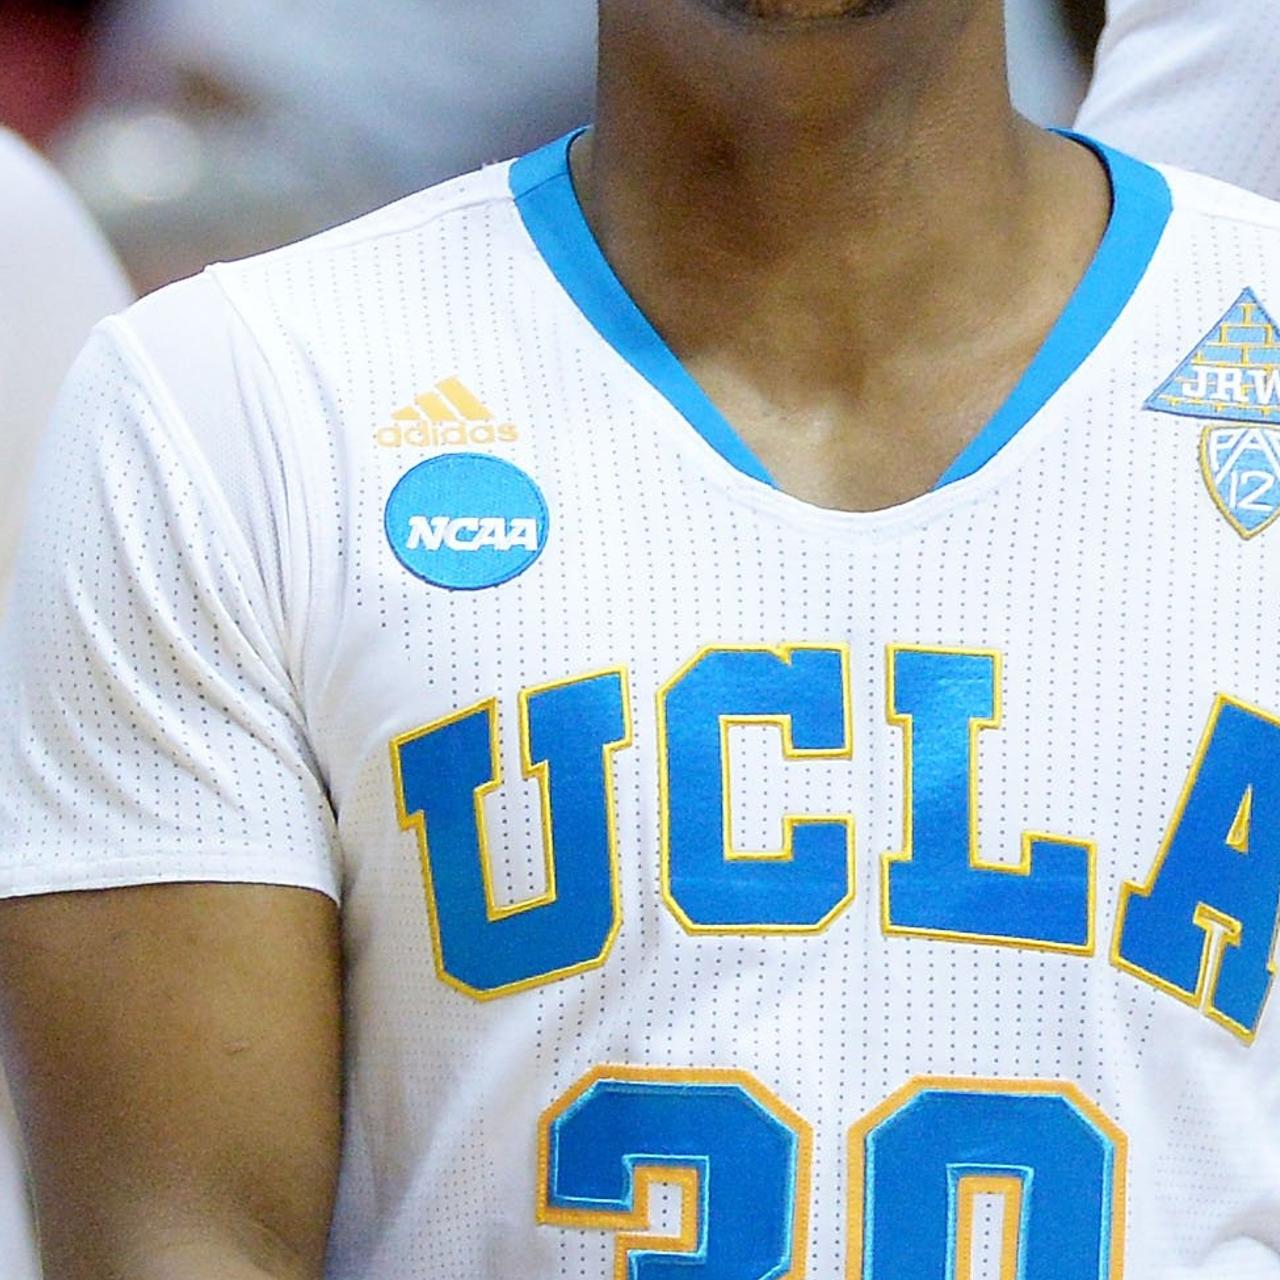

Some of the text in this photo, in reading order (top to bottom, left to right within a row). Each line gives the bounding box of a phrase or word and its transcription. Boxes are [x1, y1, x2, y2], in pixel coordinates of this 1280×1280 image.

[376, 420, 519, 448] adidas
[1229, 471, 1276, 512] 12
[405, 516, 539, 552] NCAA
